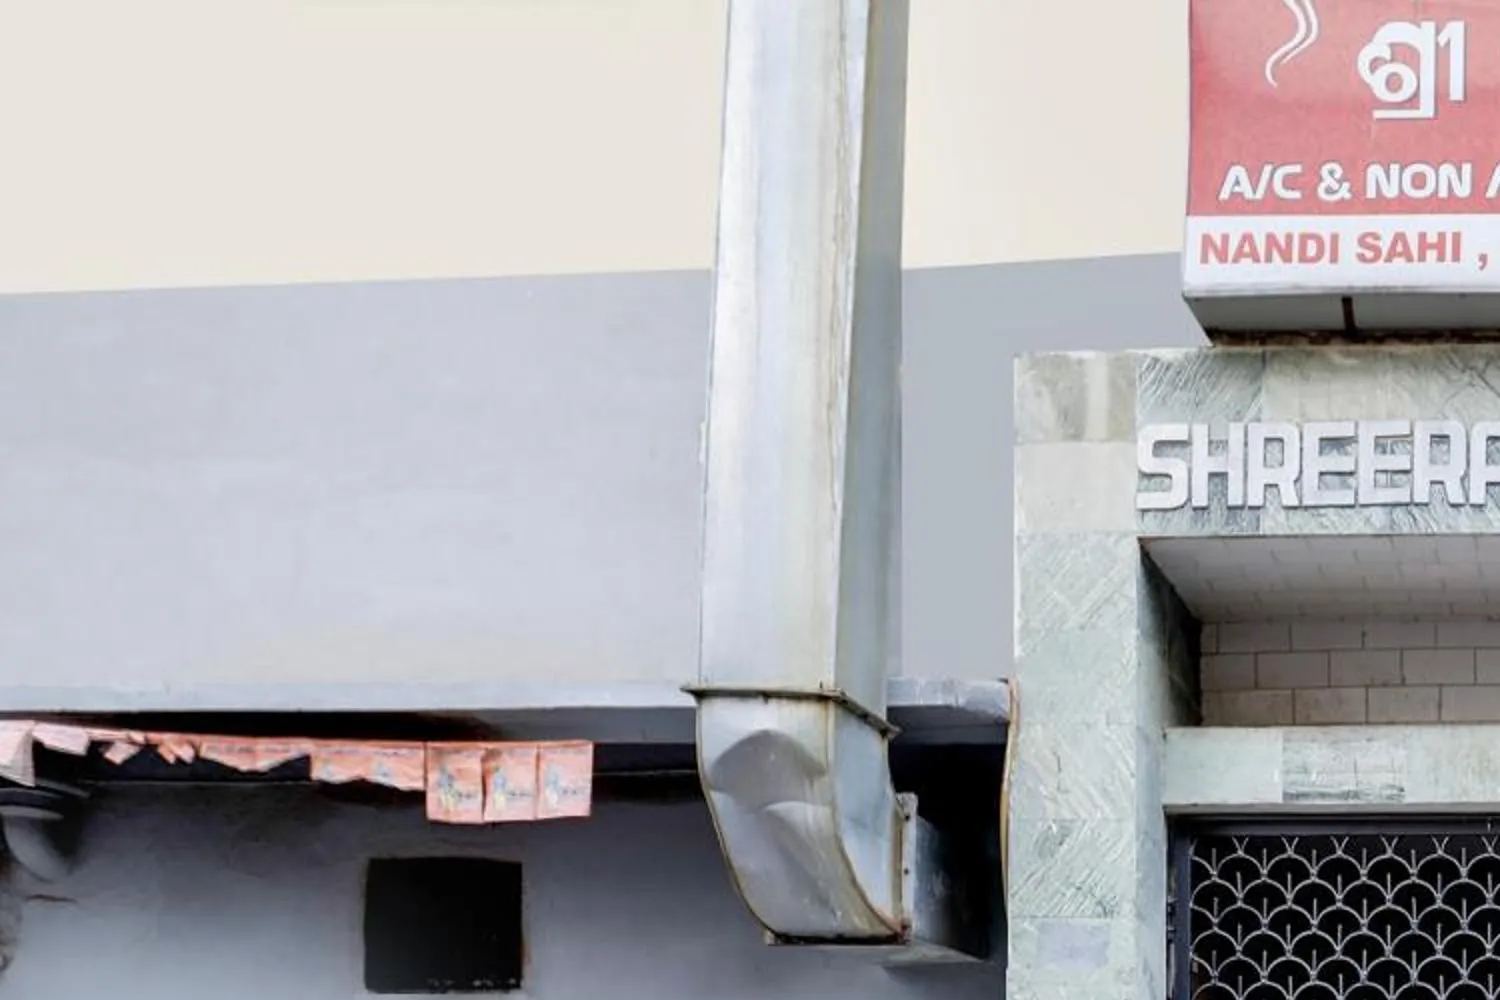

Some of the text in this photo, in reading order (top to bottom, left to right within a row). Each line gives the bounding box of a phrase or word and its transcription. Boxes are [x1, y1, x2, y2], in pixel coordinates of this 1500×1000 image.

[1218, 162, 1304, 201] A/C
[1316, 161, 1353, 201] &
[1365, 162, 1473, 198] NON
[1199, 231, 1340, 265] NANDI
[1355, 230, 1462, 264] SAHI
